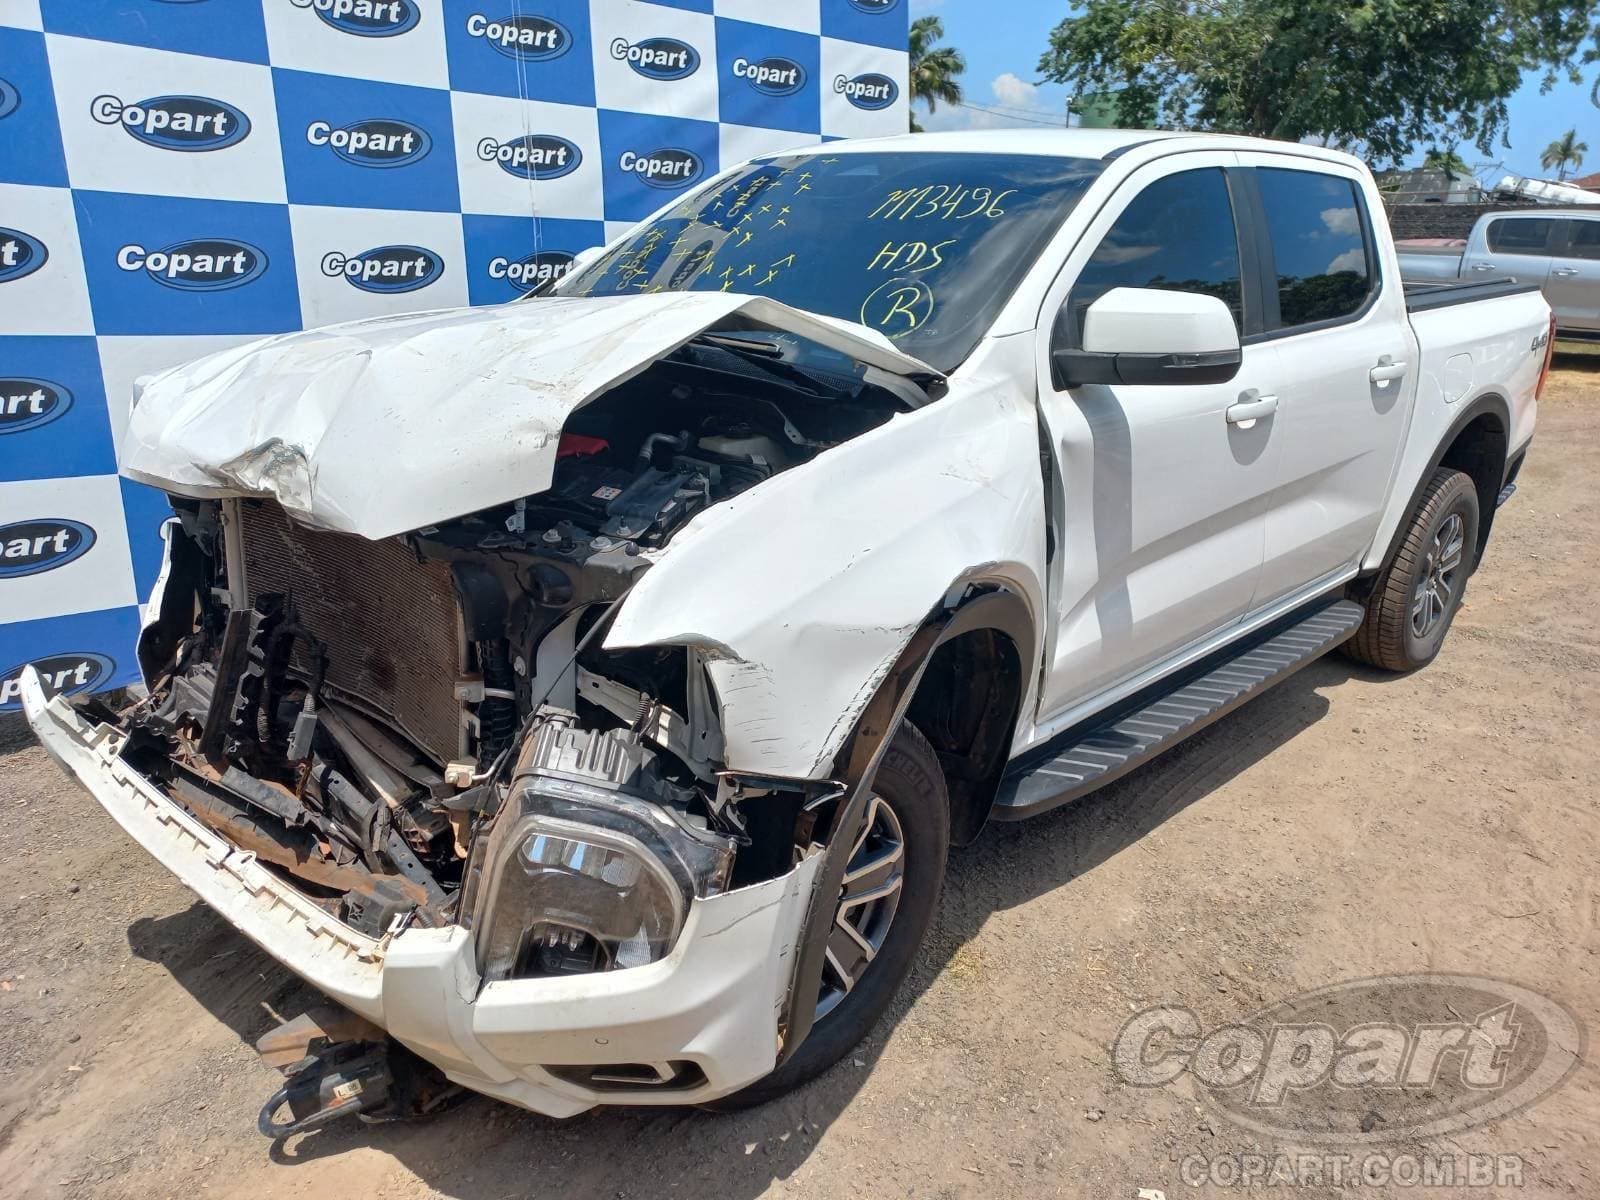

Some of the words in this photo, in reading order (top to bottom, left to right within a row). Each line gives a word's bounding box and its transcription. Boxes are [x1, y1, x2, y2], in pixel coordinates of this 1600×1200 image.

[290, 0, 400, 23] opart
[467, 14, 558, 50] Copart
[611, 38, 688, 69] Copart
[733, 58, 797, 86] Copart
[833, 75, 890, 100] Copart
[90, 95, 229, 137] Copart
[306, 121, 414, 155] Copart
[477, 138, 567, 167] Copart
[620, 151, 692, 178] Copart
[116, 245, 246, 278] Copart
[321, 252, 426, 281] Copart
[880, 286, 921, 328] R
